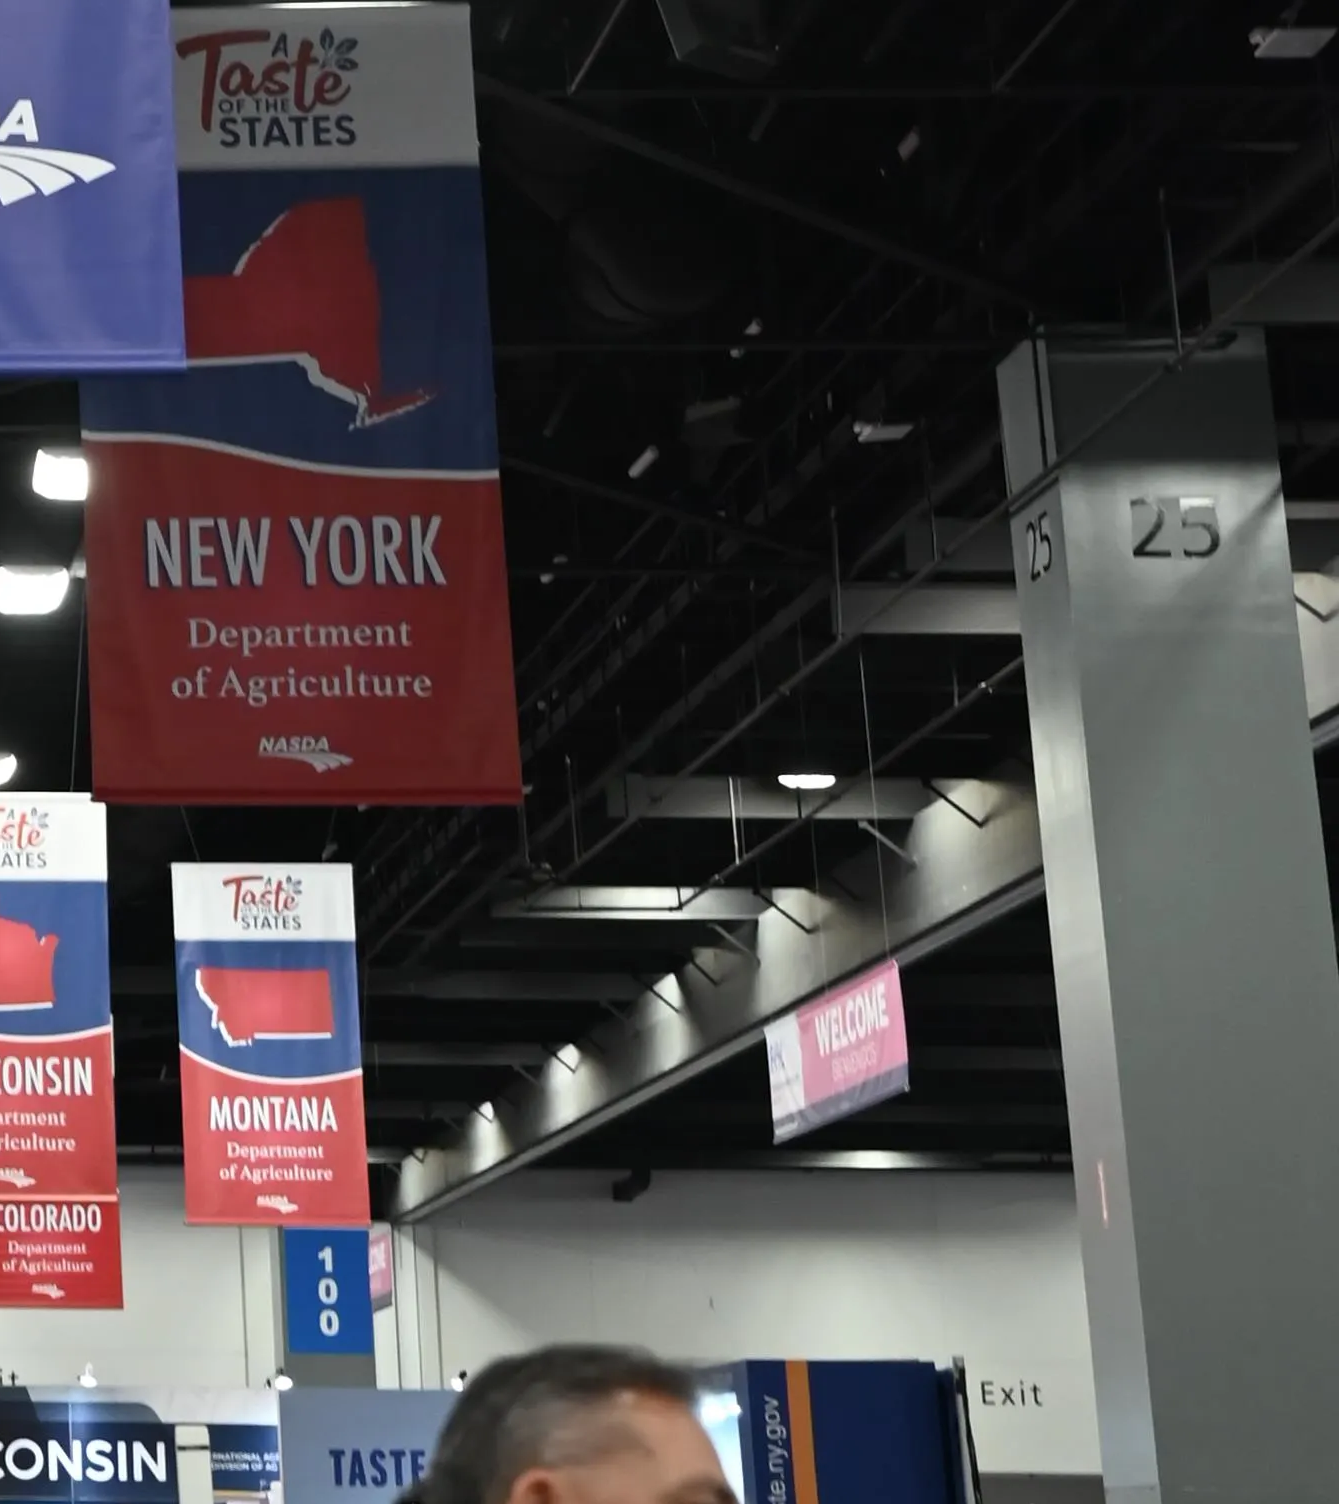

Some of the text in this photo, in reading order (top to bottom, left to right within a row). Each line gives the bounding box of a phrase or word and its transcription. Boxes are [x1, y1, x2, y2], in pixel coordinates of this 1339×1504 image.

[271, 32, 289, 58] A
[175, 29, 352, 133] Taste
[218, 98, 290, 114] OF THE
[219, 115, 357, 148] STATES
[1026, 510, 1052, 582] 25
[1130, 497, 1221, 559] 25
[144, 515, 447, 588] NEW YORK
[188, 618, 412, 657] Department
[171, 664, 433, 707] of Agriculture
[258, 736, 330, 753] NASDA
[222, 875, 299, 922] Taste
[241, 915, 302, 930] STATES
[814, 981, 890, 1058] WELCOME
[210, 1095, 339, 1132] MONTANA
[227, 1141, 324, 1162] Department
[219, 1164, 333, 1184] of Agriculture
[2, 1259, 94, 1275] of Agriculture
[8, 1240, 87, 1257] Department
[318, 1246, 339, 1336] 100
[981, 1380, 1043, 1407] Exit
[329, 1448, 426, 1488] TASTE
